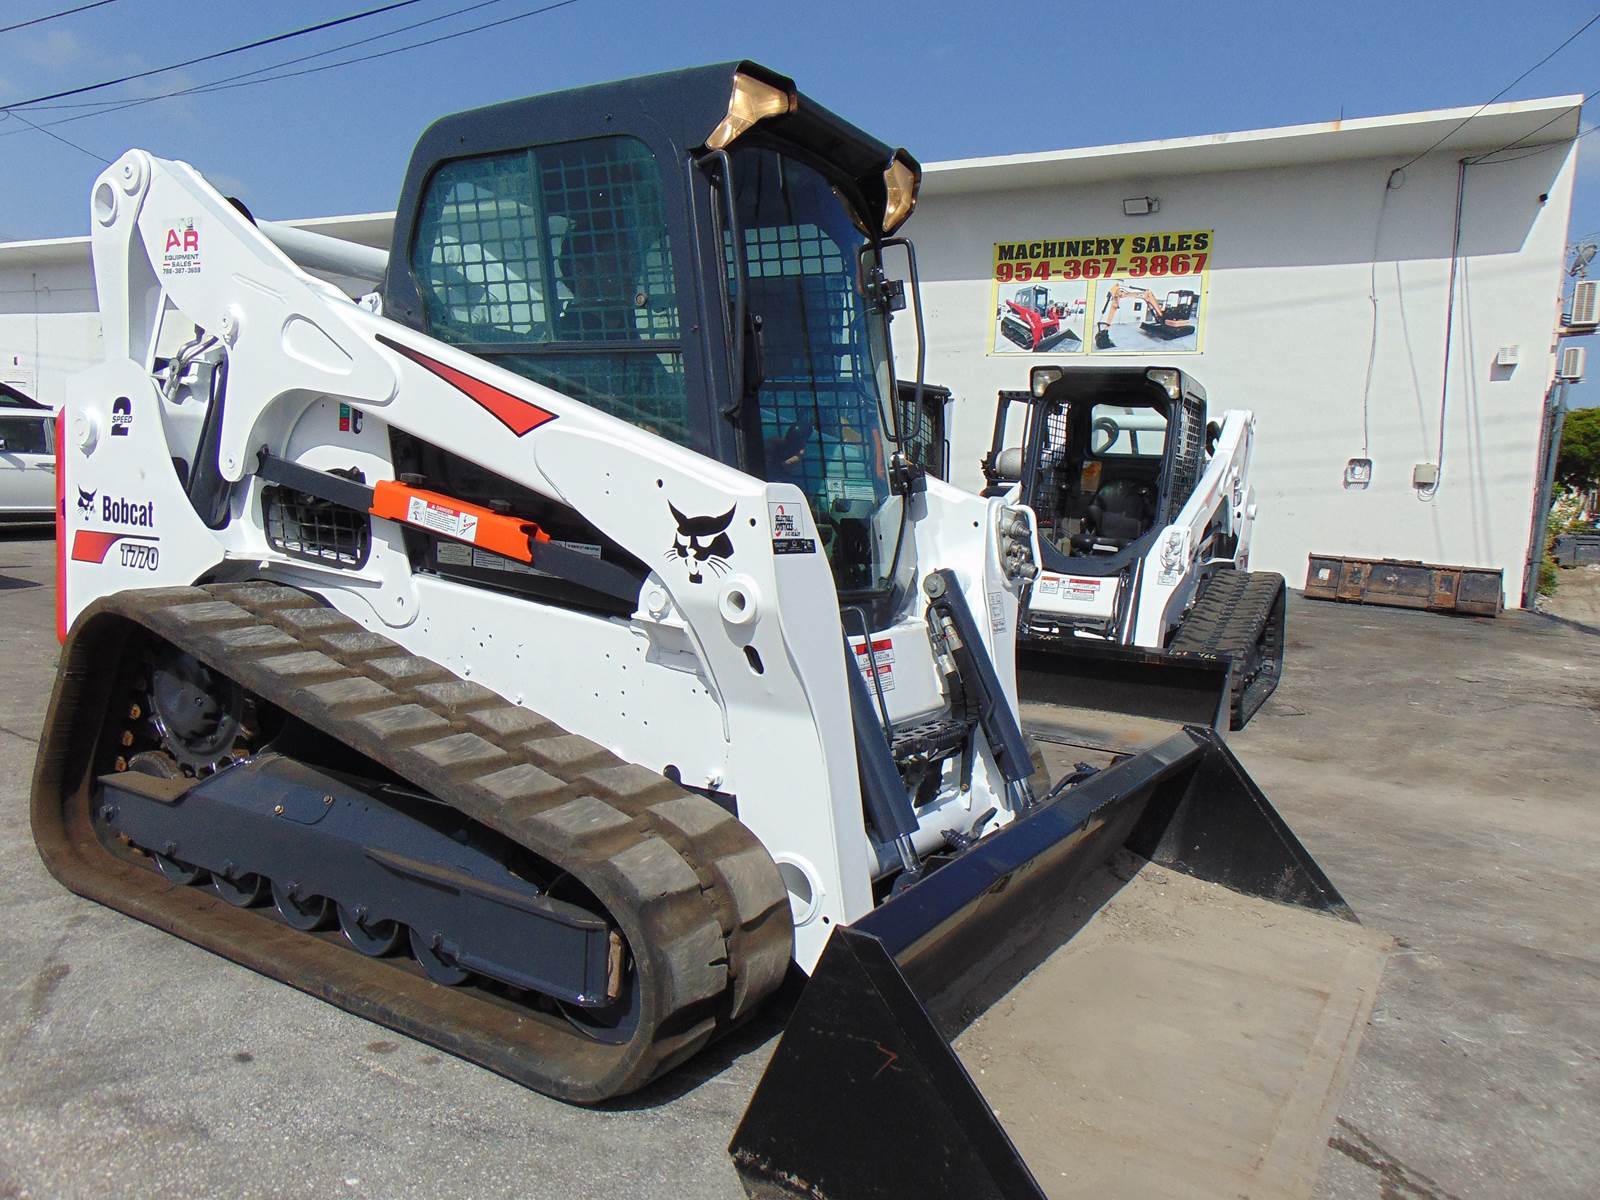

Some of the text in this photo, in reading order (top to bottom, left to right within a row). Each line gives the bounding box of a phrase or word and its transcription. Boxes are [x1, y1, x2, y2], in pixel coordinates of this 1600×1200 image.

[998, 232, 1209, 261] MACHINERY SALES
[996, 252, 1208, 283] 954-367-3867
[111, 396, 132, 436] 2
[111, 415, 133, 424] SPEED
[102, 495, 154, 528] Bobcat
[120, 543, 159, 571] T770
